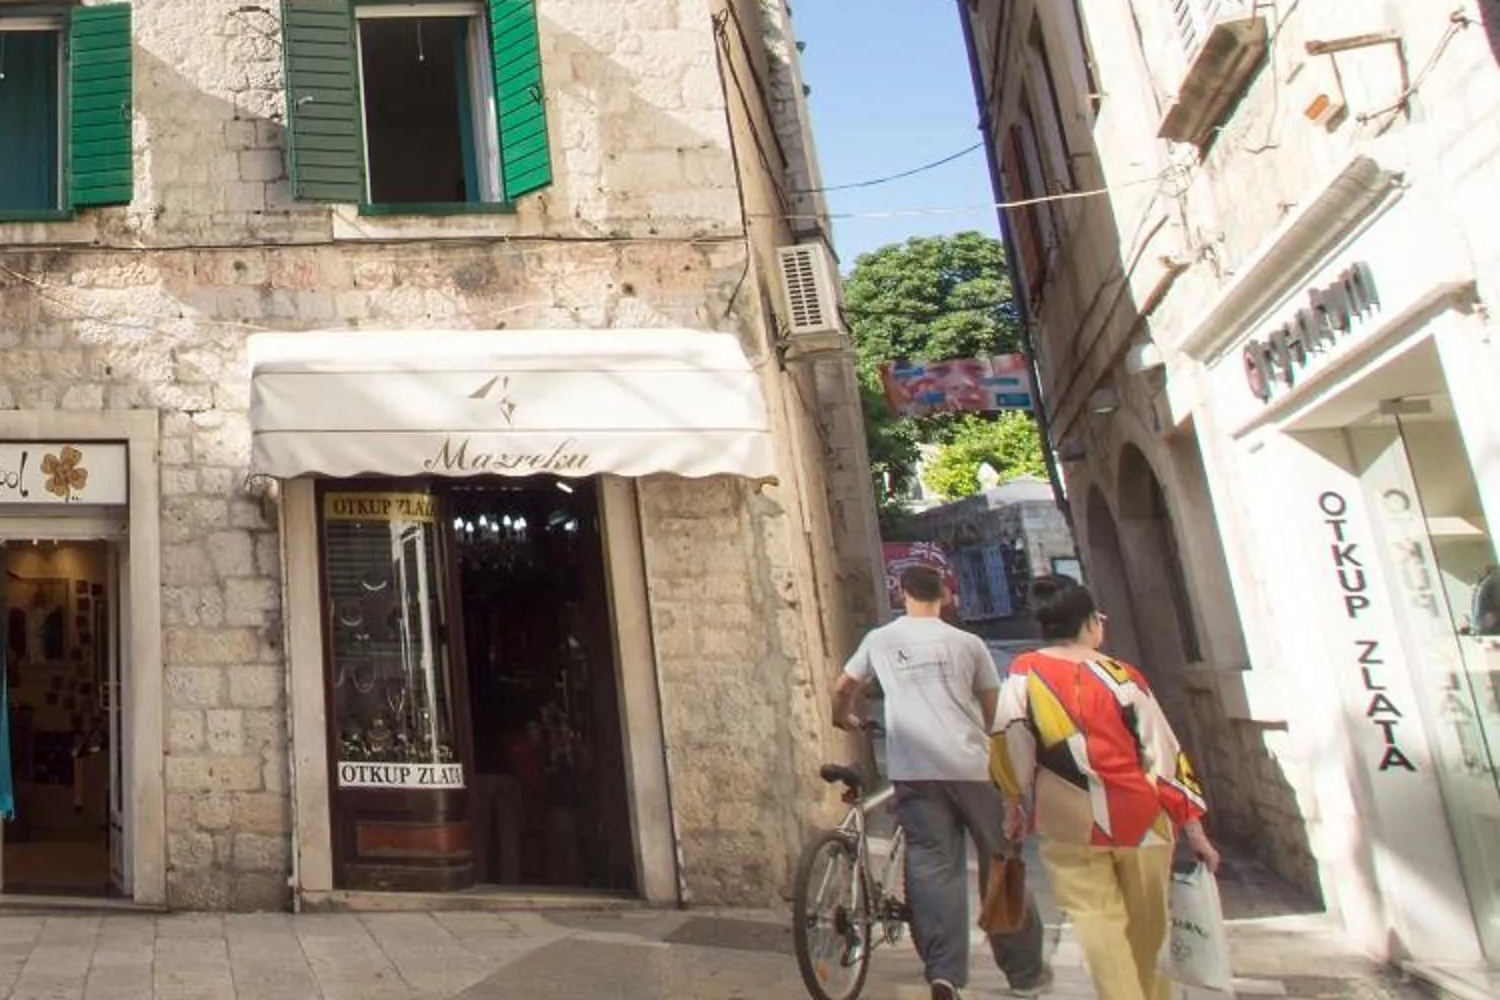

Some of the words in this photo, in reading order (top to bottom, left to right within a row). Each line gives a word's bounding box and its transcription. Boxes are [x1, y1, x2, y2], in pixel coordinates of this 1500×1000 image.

[423, 437, 591, 471] Mazreku
[333, 498, 391, 515] OTKUP
[1318, 491, 1369, 618] OTKUP
[1354, 640, 1417, 772] ZLATA
[341, 764, 411, 784] OTKUP
